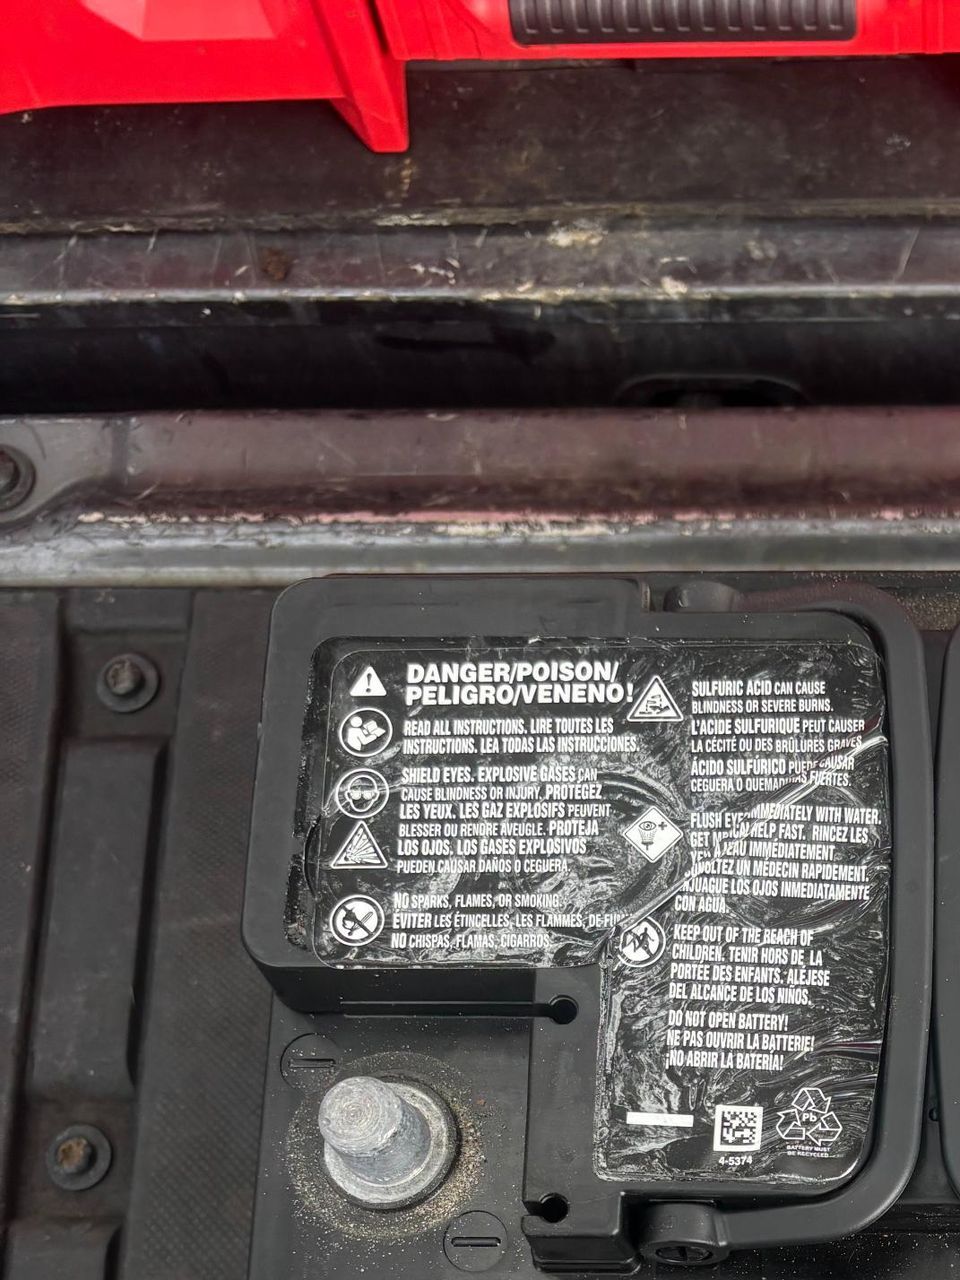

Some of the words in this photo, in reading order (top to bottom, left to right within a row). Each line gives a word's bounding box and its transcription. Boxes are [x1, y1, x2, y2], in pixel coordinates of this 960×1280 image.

[407, 662, 618, 684] DANGER/POISON/
[406, 683, 634, 706] PELIGRO/VENENO!
[692, 680, 743, 697] SULFURIC
[746, 681, 772, 696] ACID
[774, 682, 793, 695] CAN
[796, 682, 825, 694] CAUSE
[692, 700, 743, 714] BLINDNESS
[746, 700, 759, 712] OR
[761, 699, 796, 713] SEVERE
[799, 699, 833, 712] BURNS.
[405, 721, 430, 735] READ
[433, 720, 451, 735] ALL
[454, 718, 527, 735] INSTRUCTIONS.
[531, 718, 553, 733] LIRE
[555, 718, 592, 733] TOUTES
[595, 718, 613, 733] LES
[403, 739, 478, 754] INSTRUCTIONS.
[480, 738, 499, 753] LEA
[502, 738, 534, 753] TODAS
[536, 738, 555, 752] LAS
[669, 1010, 683, 1026] DO
[685, 1012, 706, 1028] NOT
[709, 1013, 736, 1029] OPEN
[739, 1014, 788, 1030] BATTERY!
[802, 1113, 817, 1122] Pb
